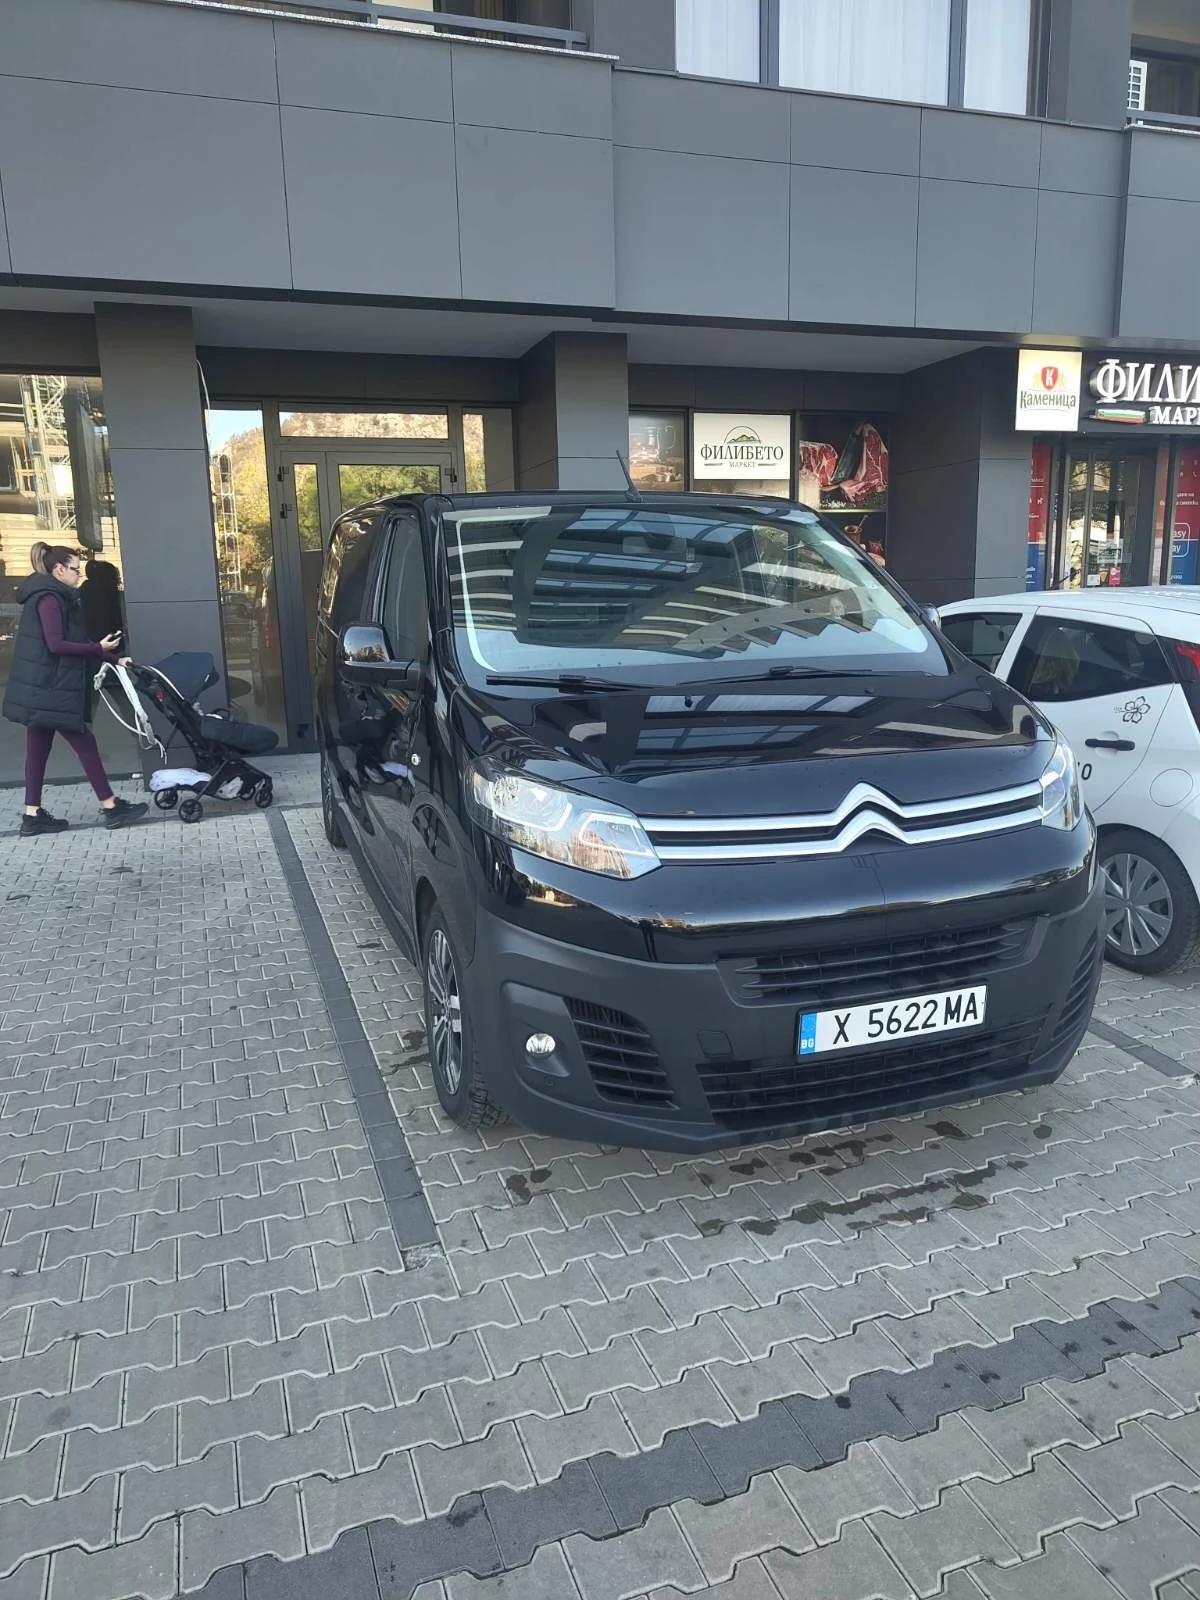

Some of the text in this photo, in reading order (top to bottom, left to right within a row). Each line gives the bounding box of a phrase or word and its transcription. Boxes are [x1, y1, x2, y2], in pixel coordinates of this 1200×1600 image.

[1020, 393, 1076, 408] Каменица
[700, 444, 784, 461] ФИЛИБЕТО
[833, 1013, 851, 1045] X
[801, 1038, 814, 1048] BG
